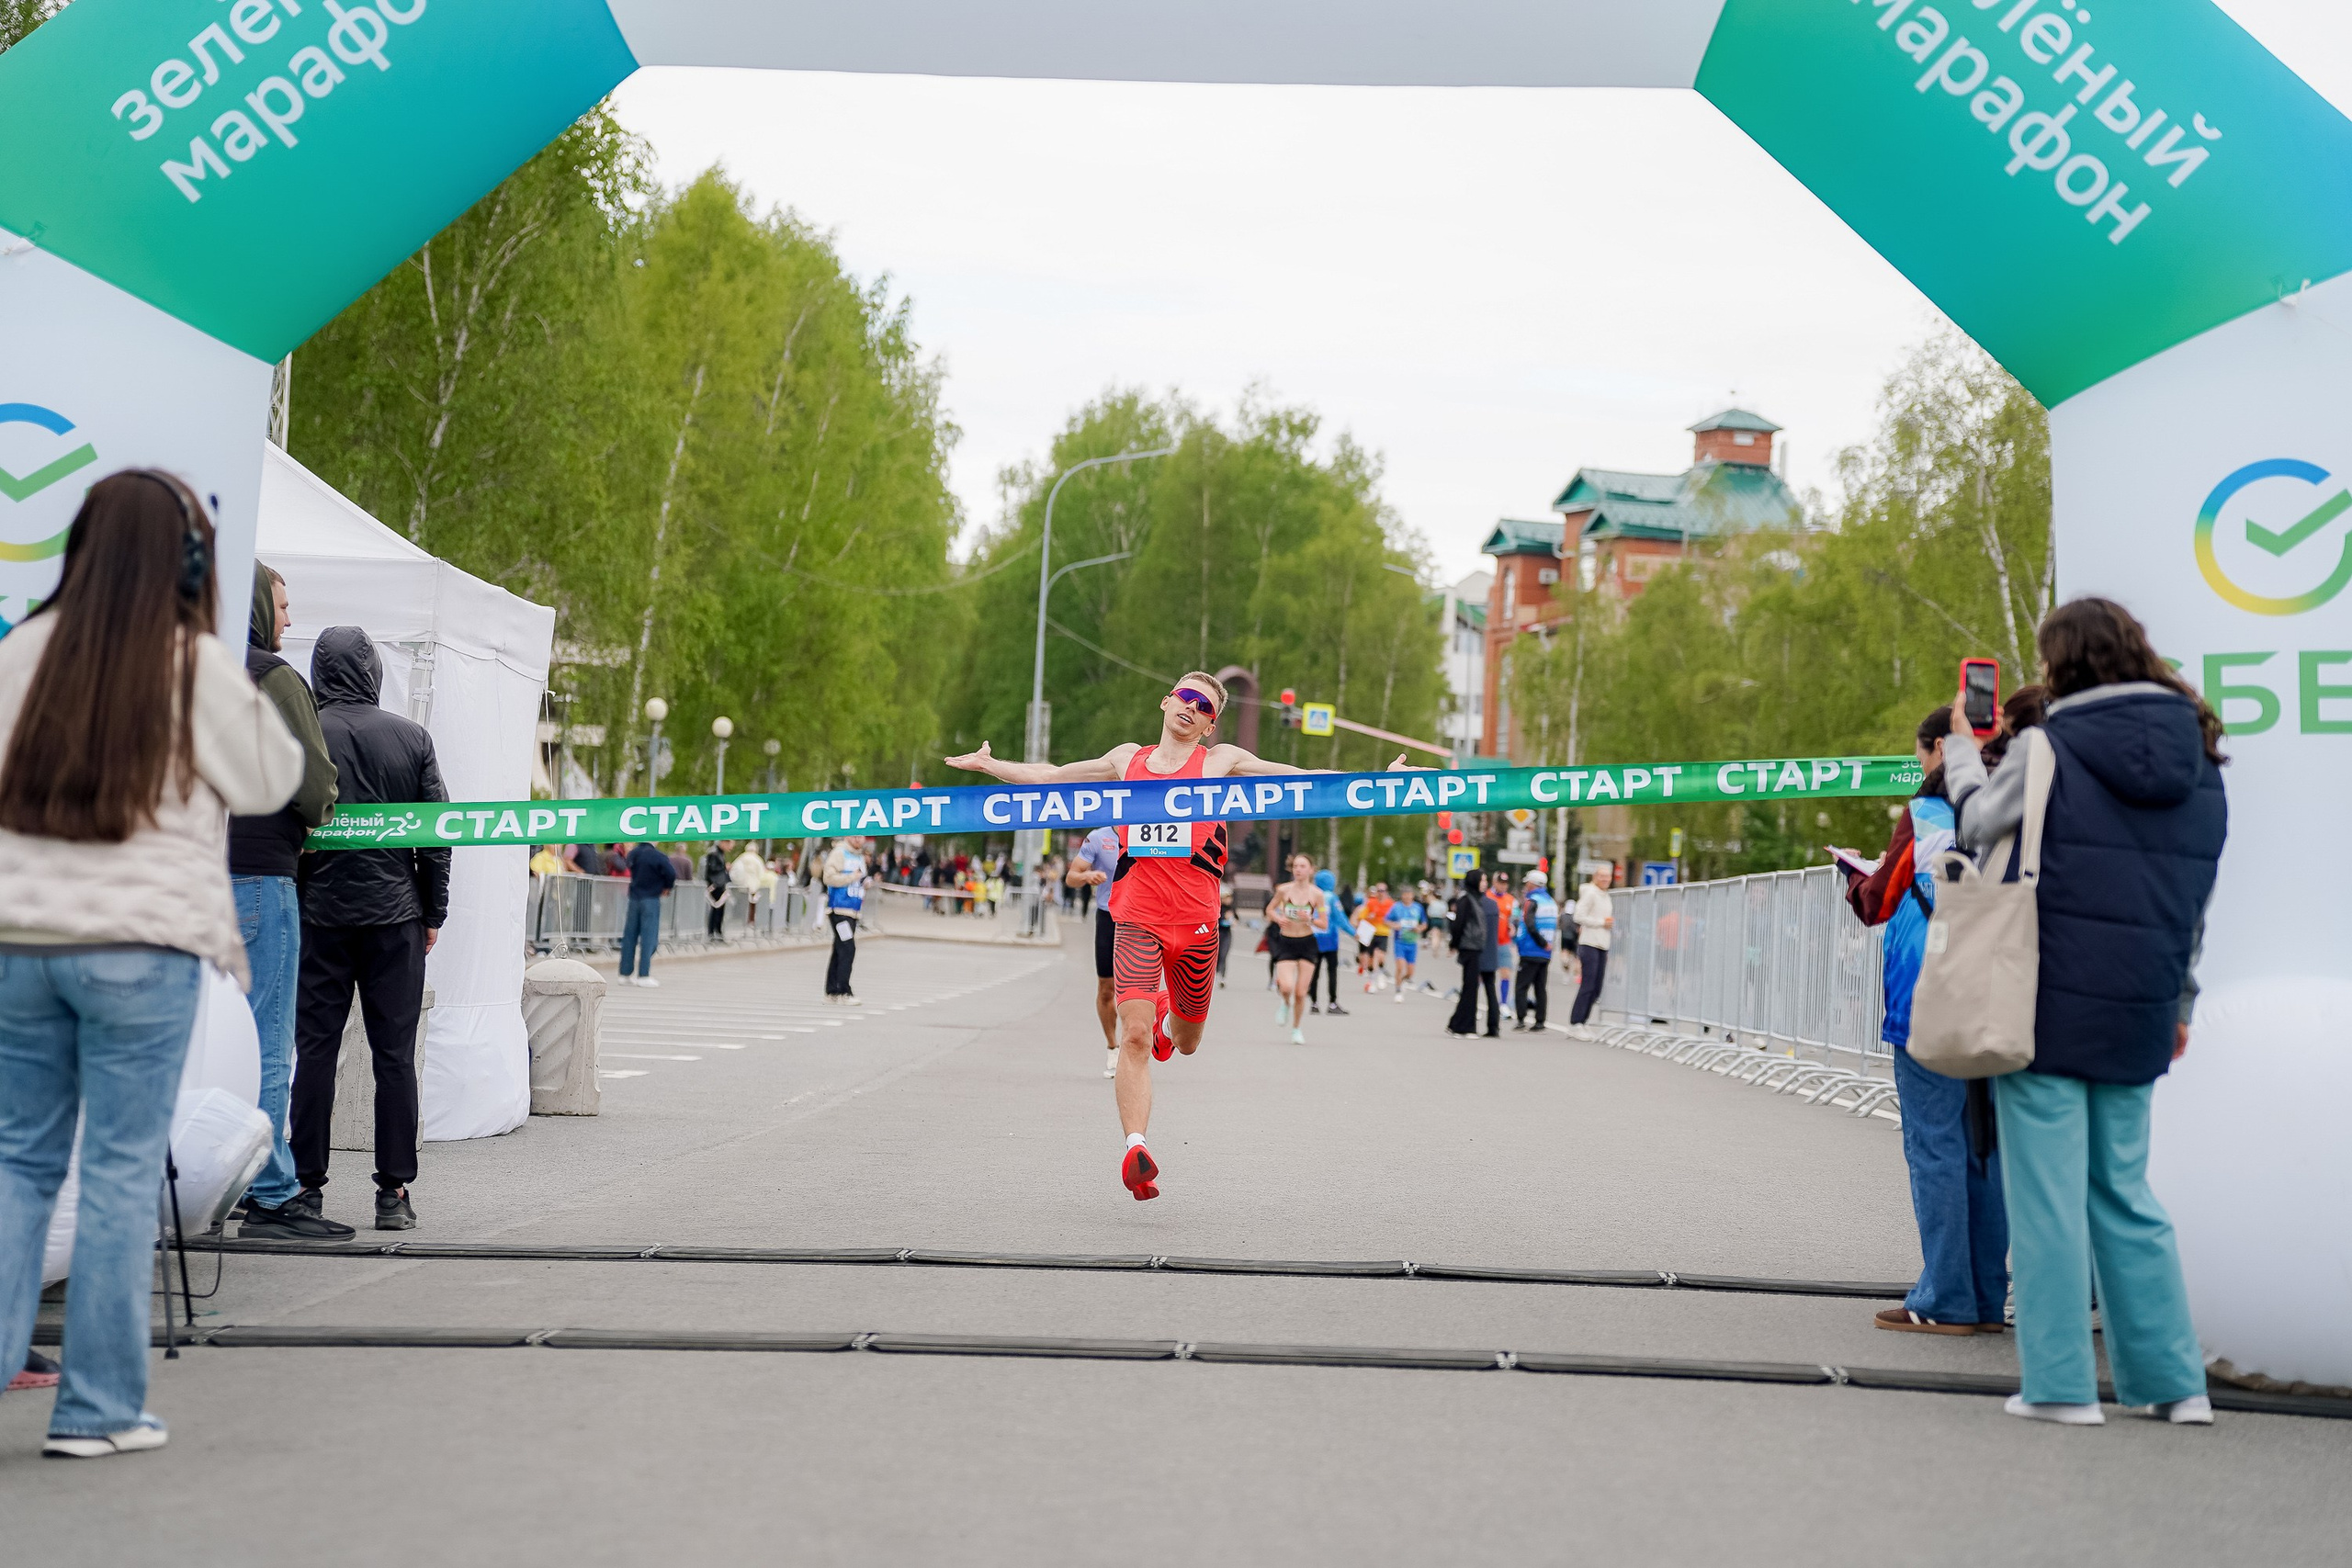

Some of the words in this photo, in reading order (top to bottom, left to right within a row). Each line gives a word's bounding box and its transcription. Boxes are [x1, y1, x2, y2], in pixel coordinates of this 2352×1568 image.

[111, 0, 301, 141] зелё
[1889, 772, 1928, 785] мар
[435, 808, 586, 840] СТАРТ
[620, 803, 769, 835] СТАРТ
[801, 796, 950, 830] СТАРТ
[982, 789, 1131, 824] СТАРТ
[1164, 782, 1312, 818] СТАРТ
[1346, 775, 1496, 809] СТАРТ
[1530, 767, 1681, 802] СТАРТ
[1716, 760, 1871, 795] СТАРТ
[325, 812, 385, 828] лёный
[309, 827, 377, 840] арафон
[1140, 824, 1179, 842] 812
